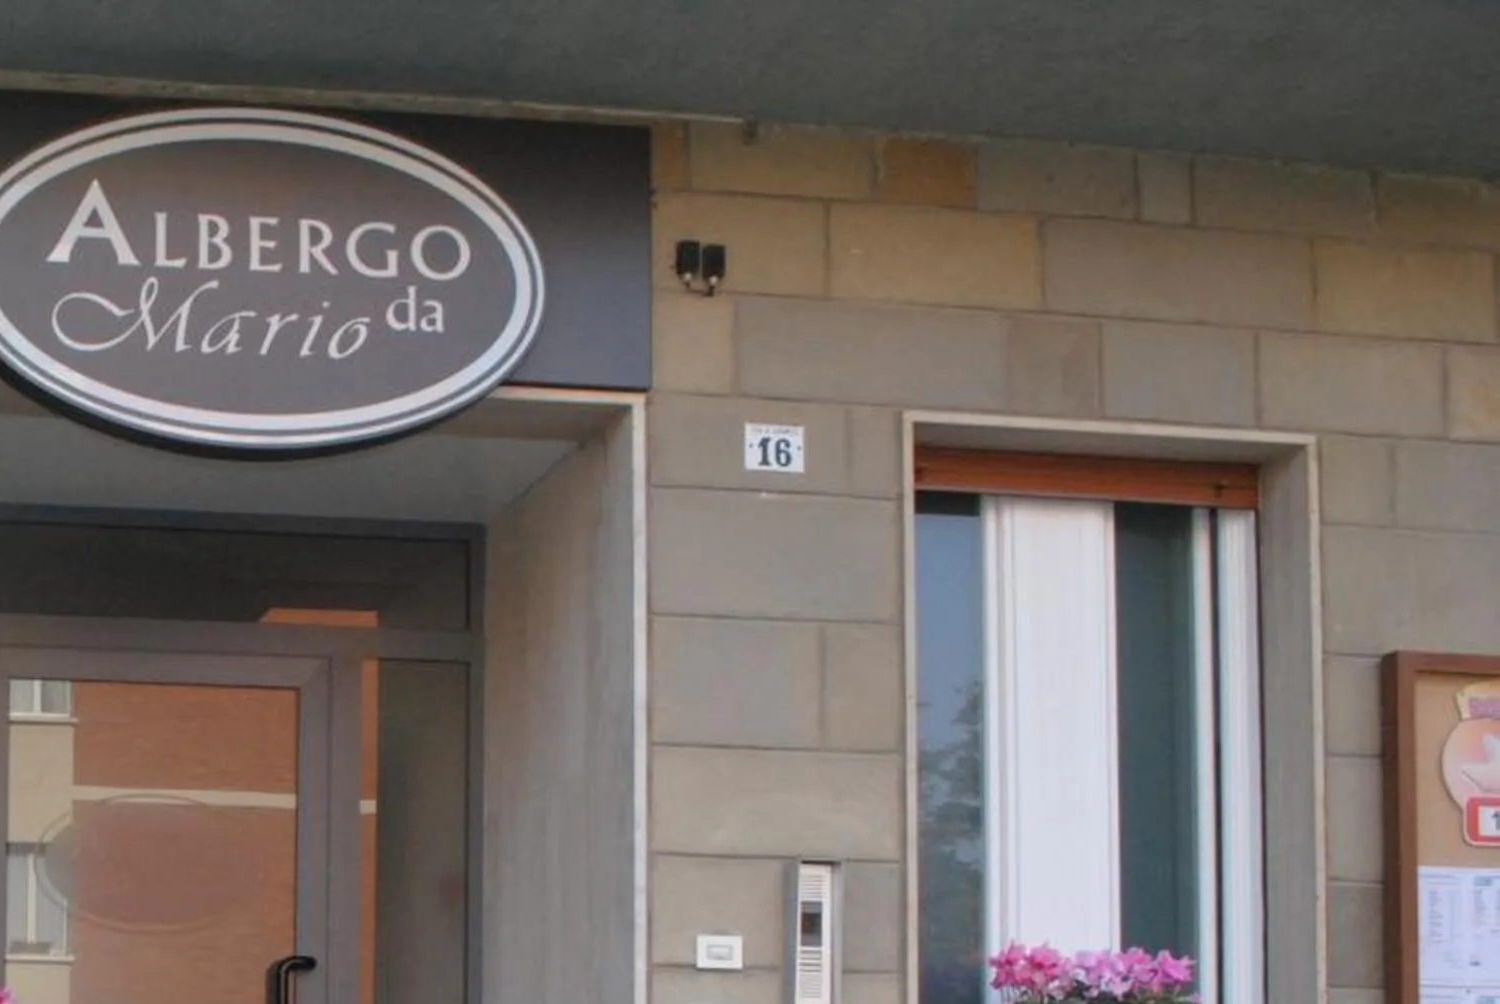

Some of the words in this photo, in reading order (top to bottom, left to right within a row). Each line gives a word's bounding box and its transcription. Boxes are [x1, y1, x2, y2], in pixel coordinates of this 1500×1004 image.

[46, 178, 471, 281] ALBERGO
[51, 276, 372, 360] Mario
[386, 286, 444, 333] da
[757, 437, 793, 467] 16
